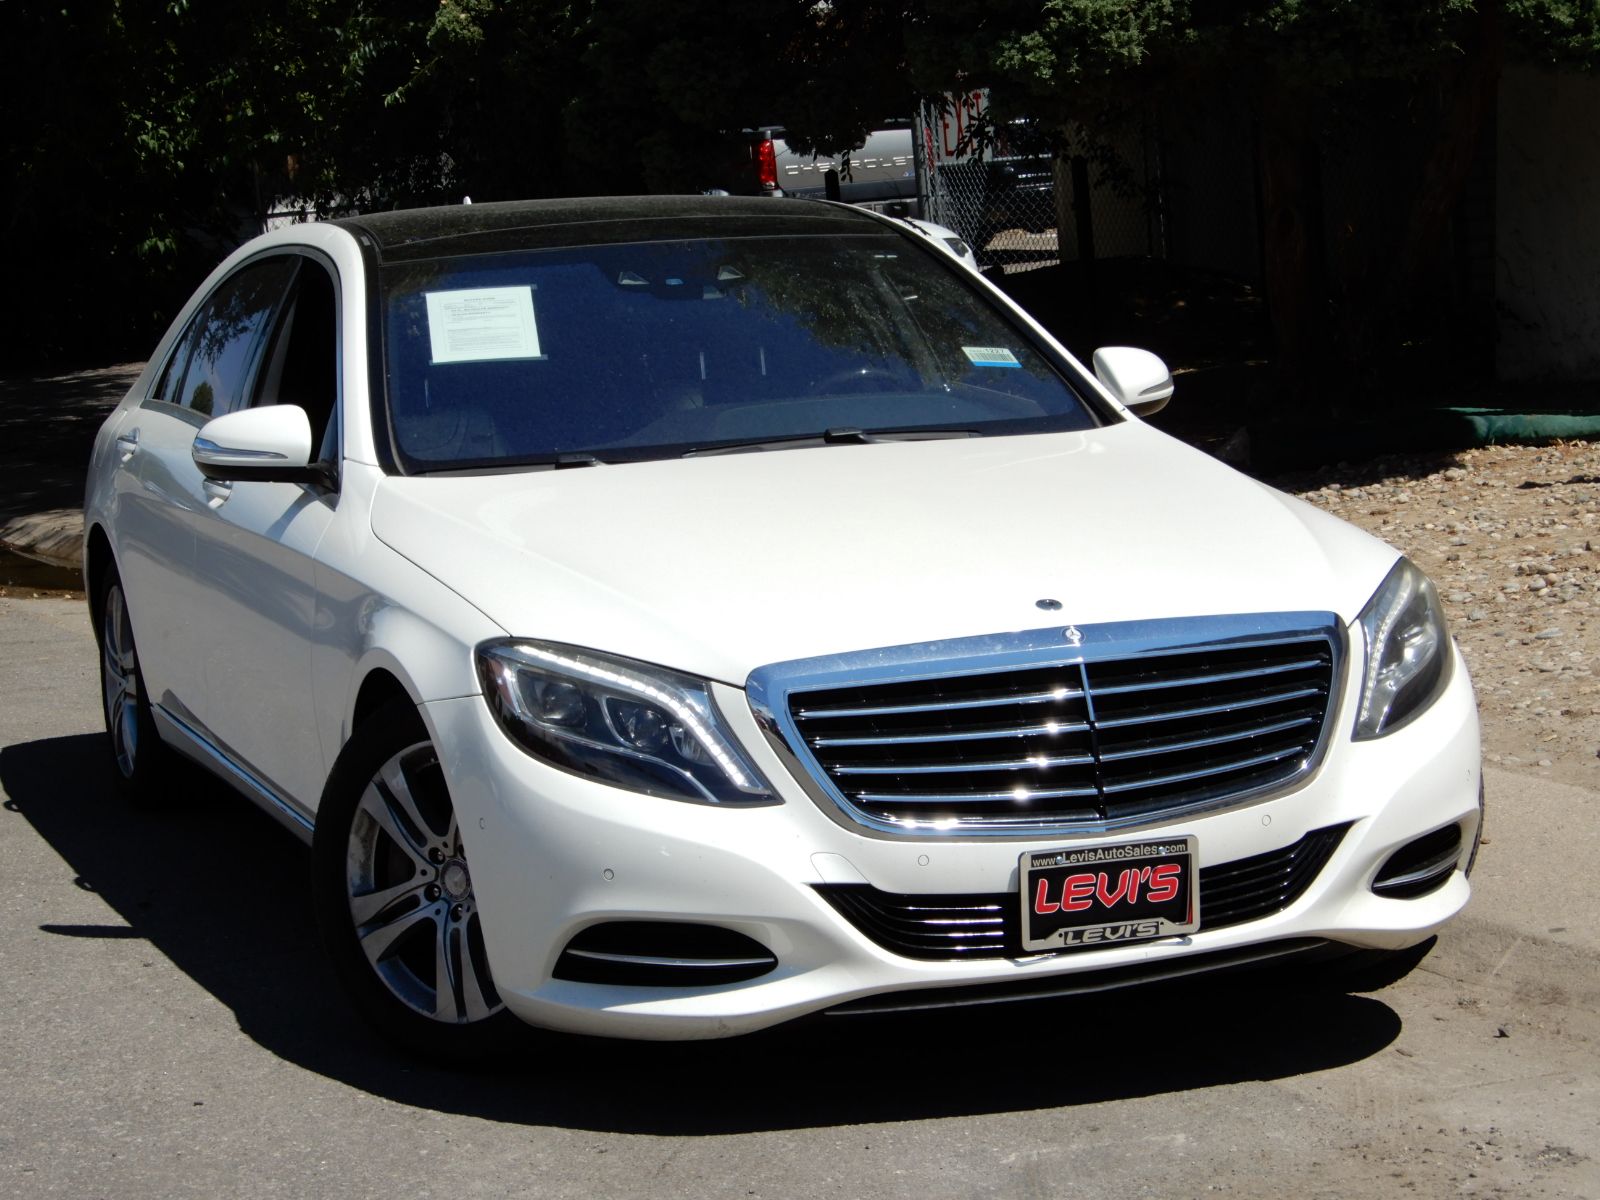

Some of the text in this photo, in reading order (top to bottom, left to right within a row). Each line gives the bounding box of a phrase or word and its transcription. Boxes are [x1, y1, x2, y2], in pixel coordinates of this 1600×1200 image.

[786, 155, 914, 175] CHEVROLE
[1032, 844, 1186, 867] wwwLevisAutoSalescom
[1035, 863, 1181, 914] LEVI'S
[1065, 921, 1158, 945] LEVI'S
